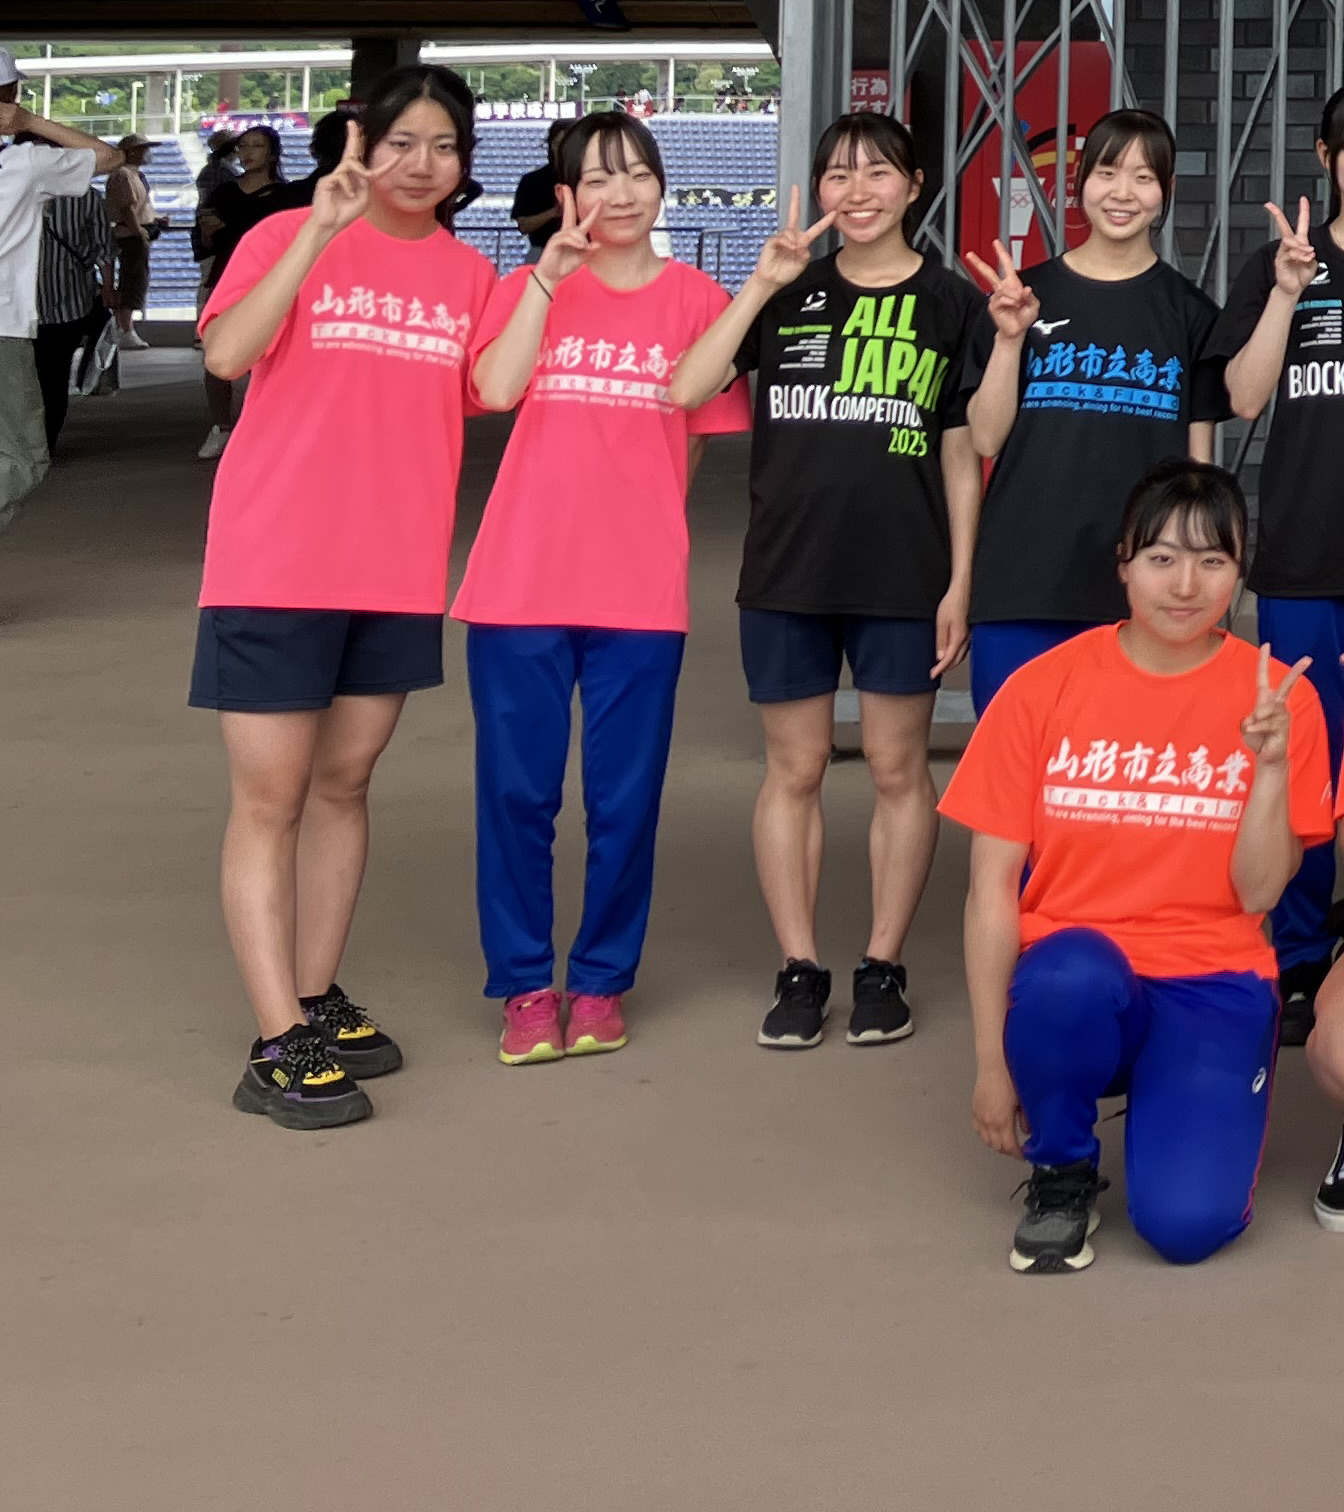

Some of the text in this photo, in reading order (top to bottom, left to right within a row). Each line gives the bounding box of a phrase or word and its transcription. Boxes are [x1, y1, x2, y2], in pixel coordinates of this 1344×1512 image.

[851, 77, 888, 96] 行為
[841, 293, 917, 341] ALL
[769, 384, 923, 428] BLOCK COMPETITIO
[1030, 385, 1178, 409] rack&Field
[887, 426, 928, 457] 2025
